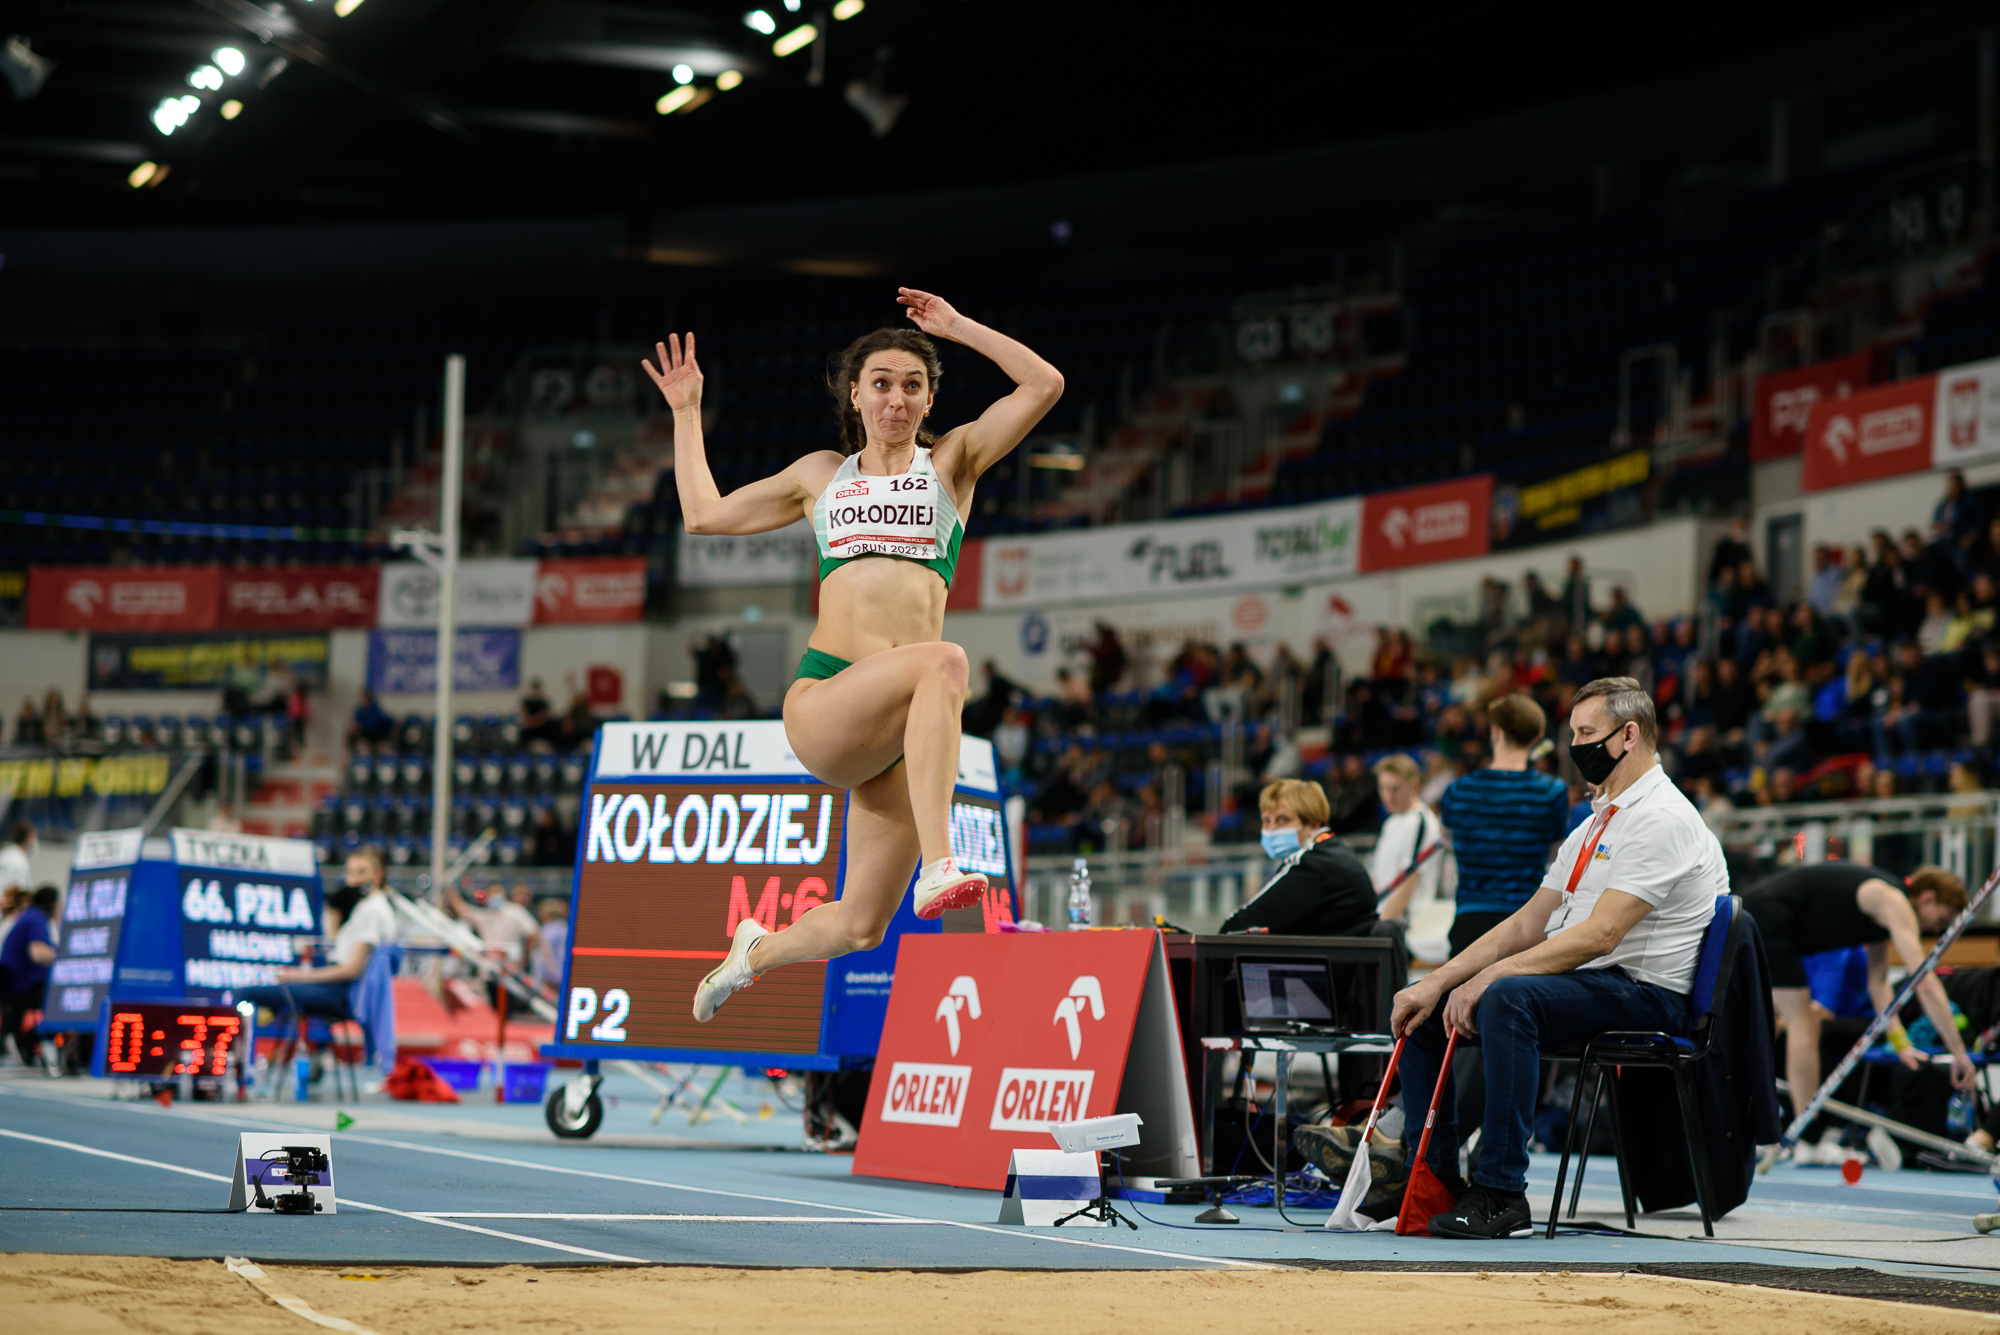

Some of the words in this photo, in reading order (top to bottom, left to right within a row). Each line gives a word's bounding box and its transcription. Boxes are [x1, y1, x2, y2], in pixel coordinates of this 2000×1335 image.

[836, 488, 868, 499] ORLEN
[890, 477, 928, 492] 162
[829, 504, 934, 530] KOŁODZIEJ
[847, 542, 887, 555] TORUŃ
[890, 544, 918, 556] 2022
[631, 733, 668, 770] W
[681, 732, 751, 770] DAL
[586, 793, 833, 865] KOŁODZIEJ
[187, 837, 269, 865] TYCZKA
[182, 877, 234, 924] 66.
[234, 882, 315, 932] PZLA
[108, 1012, 241, 1076] 0:37
[891, 1072, 963, 1117] ORLEN
[1000, 1078, 1086, 1122] ORLEN
